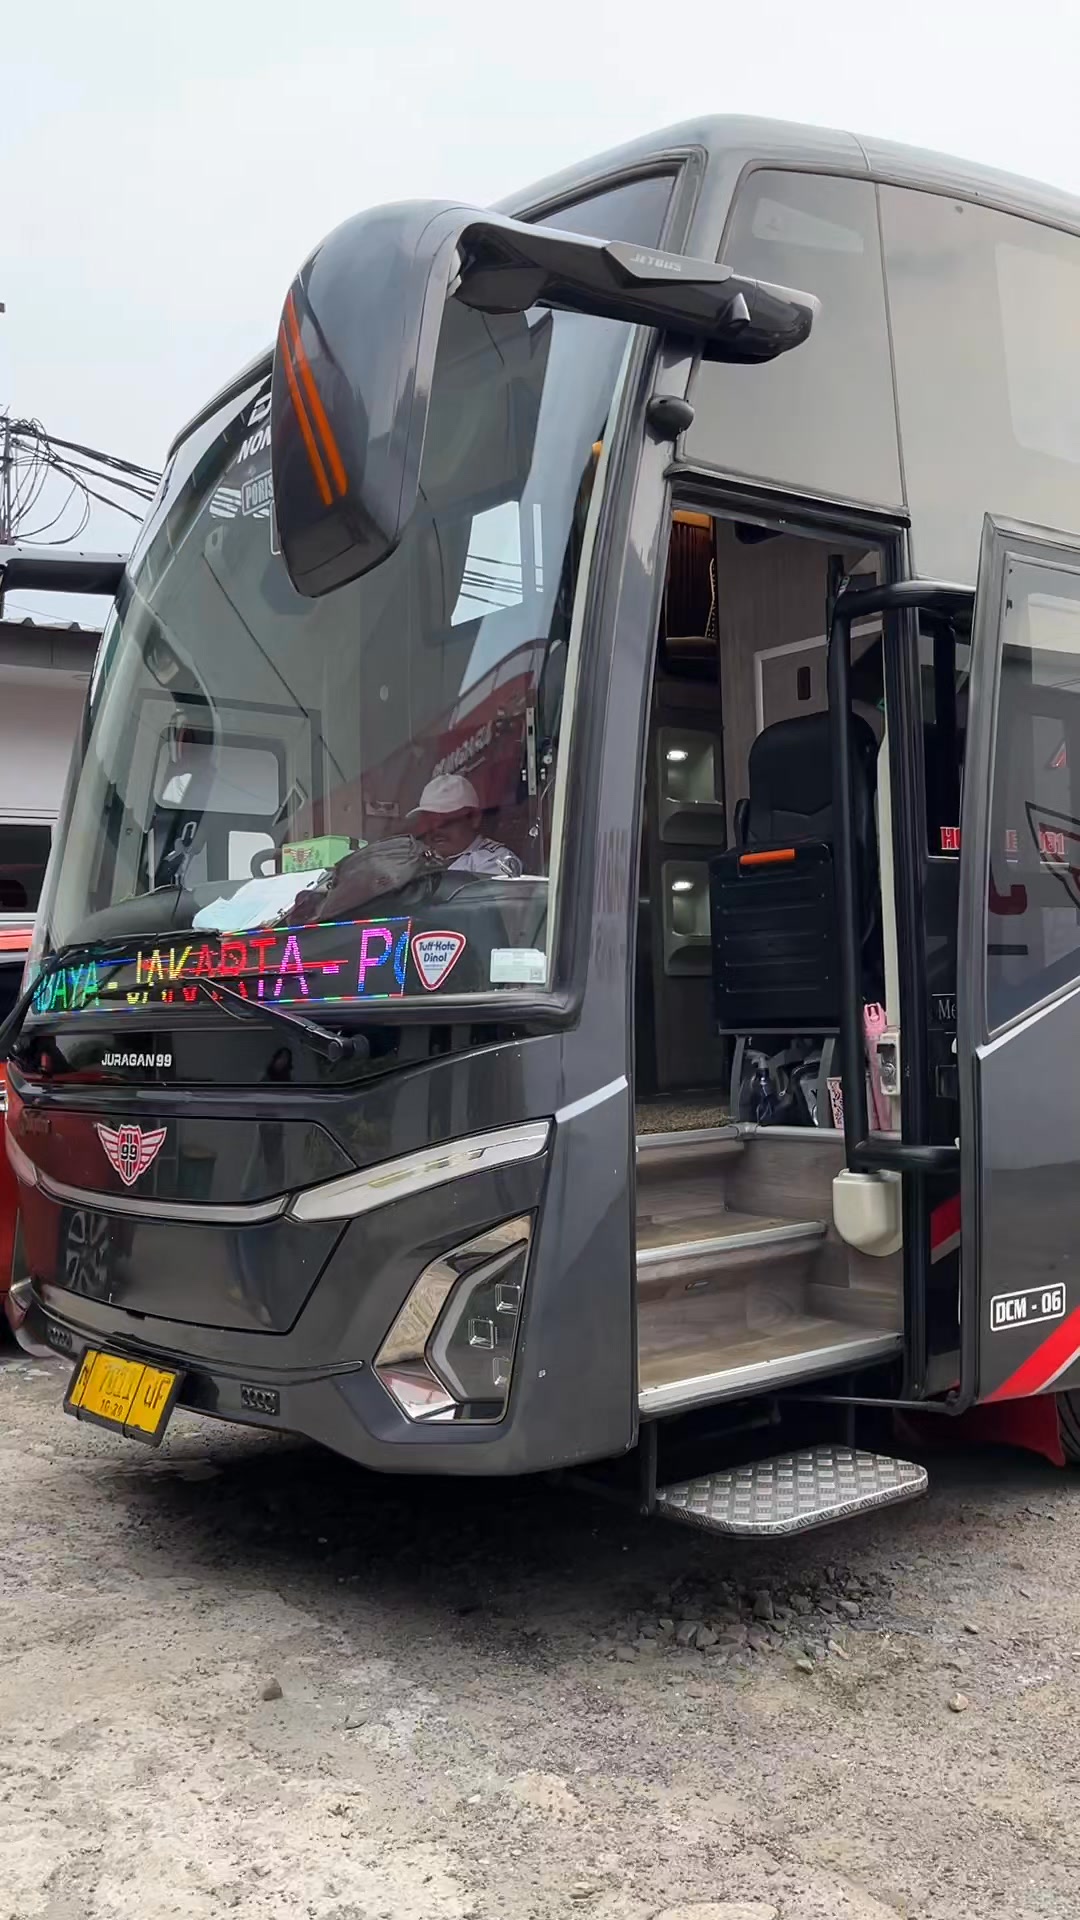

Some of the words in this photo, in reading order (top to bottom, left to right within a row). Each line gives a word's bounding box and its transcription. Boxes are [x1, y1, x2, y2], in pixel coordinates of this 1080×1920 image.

[423, 952, 448, 963] Dinol
[101, 1053, 155, 1067] JURAGAN
[156, 1053, 172, 1067] 99
[120, 1143, 138, 1160] 99
[995, 1297, 1027, 1324] DCM
[1041, 1290, 1061, 1313] 06
